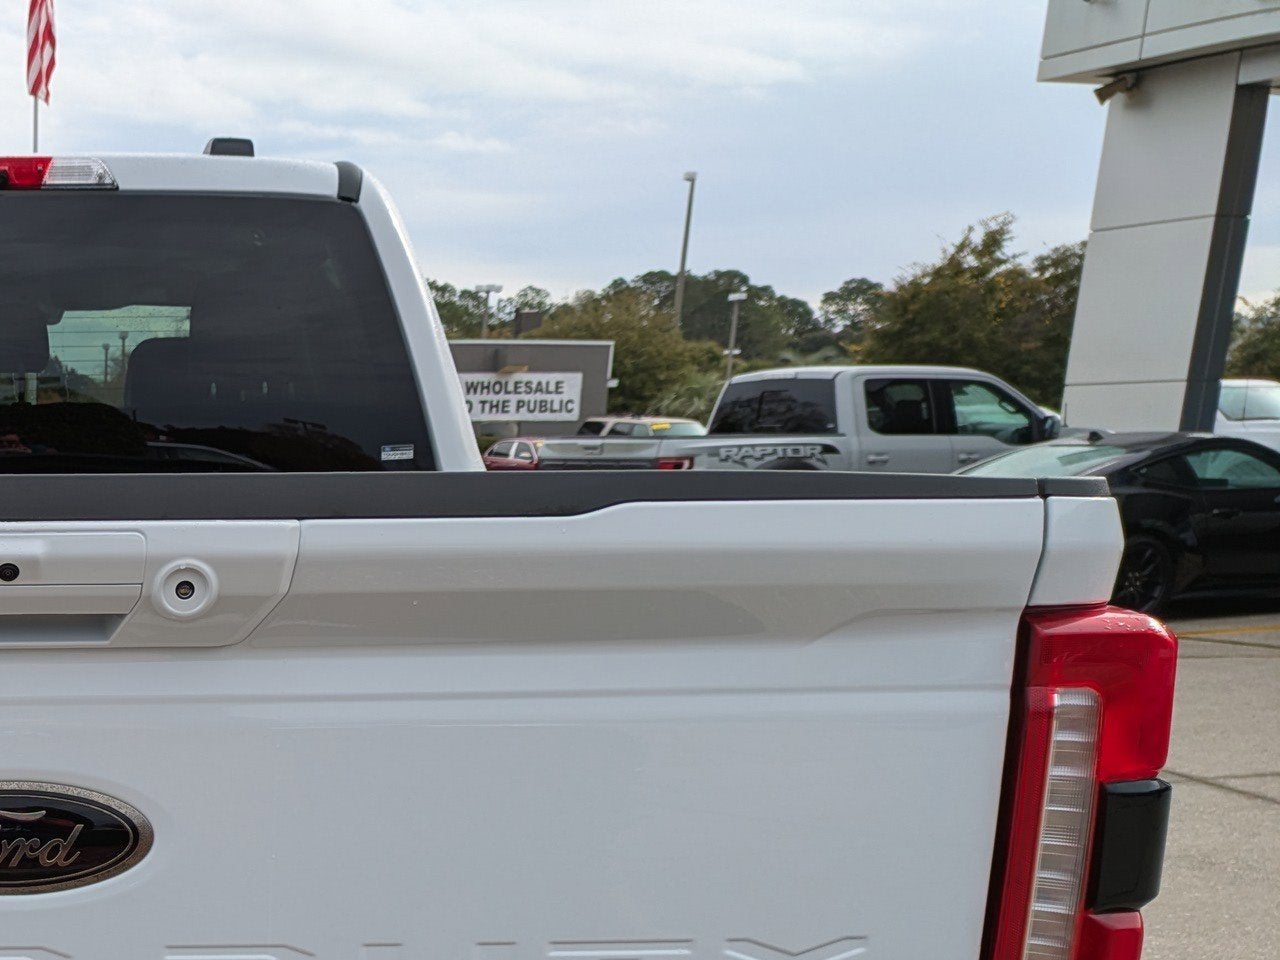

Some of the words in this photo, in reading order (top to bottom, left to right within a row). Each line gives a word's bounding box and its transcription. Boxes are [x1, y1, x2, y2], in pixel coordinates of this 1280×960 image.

[465, 381, 564, 395] WHOLESALE
[480, 400, 511, 414] THE
[516, 399, 575, 414] PUBLIC
[718, 445, 828, 468] RAPTOR
